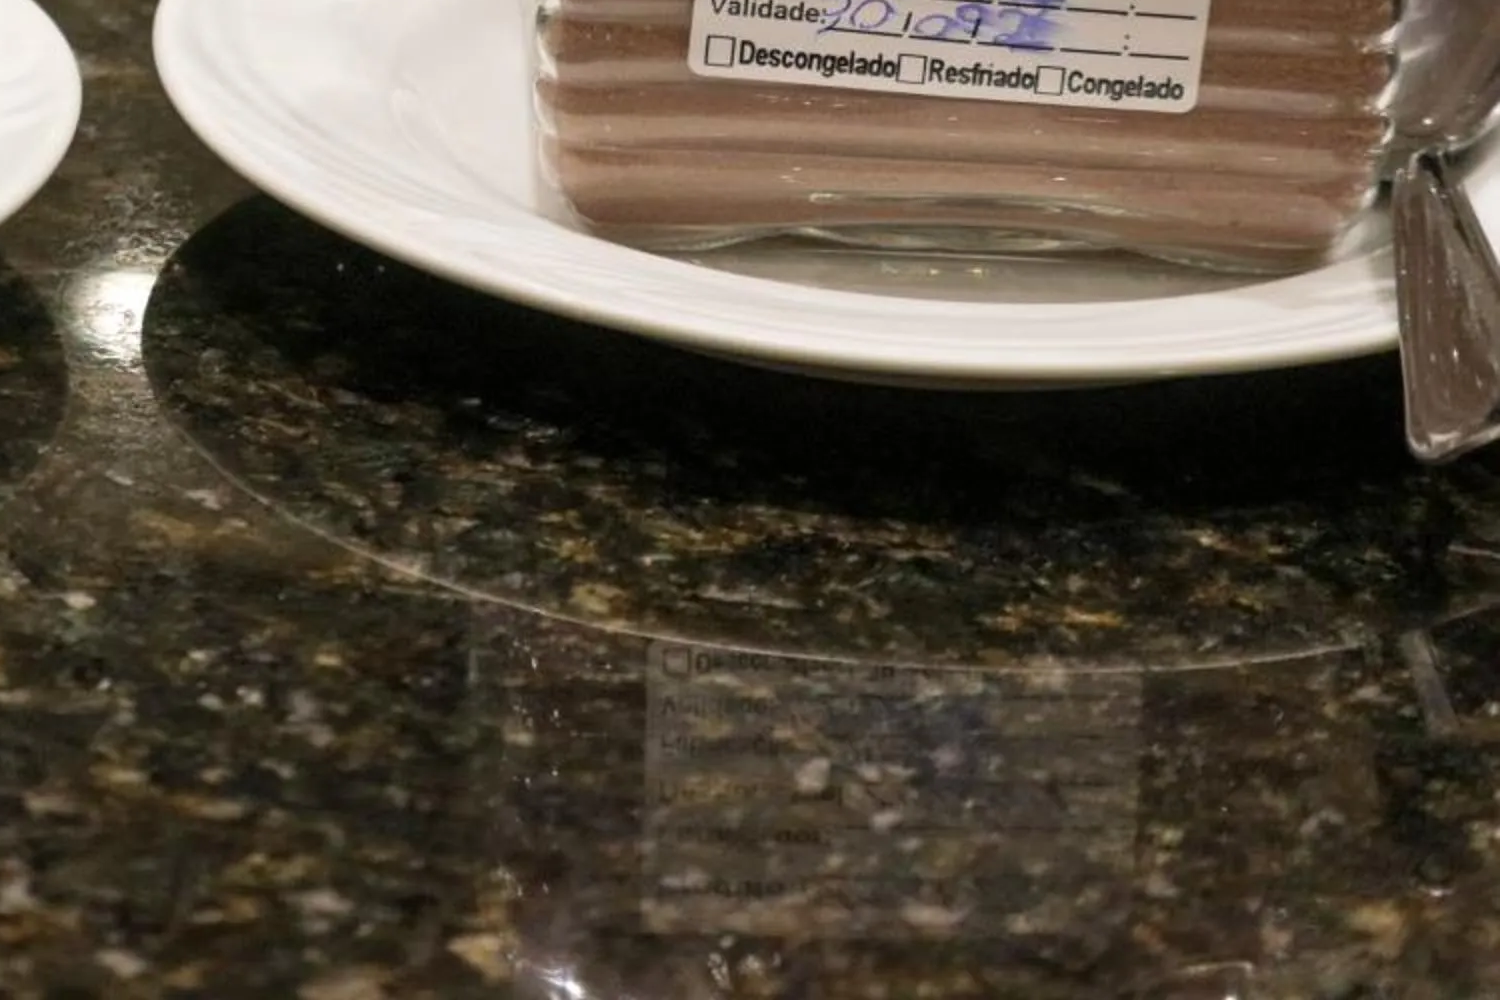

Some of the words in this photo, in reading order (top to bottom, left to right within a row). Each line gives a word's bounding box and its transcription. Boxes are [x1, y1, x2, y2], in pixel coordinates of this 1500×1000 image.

[738, 39, 898, 79] Descongelado
[928, 59, 1036, 91] Resfriado
[1066, 70, 1185, 102] Congelado
